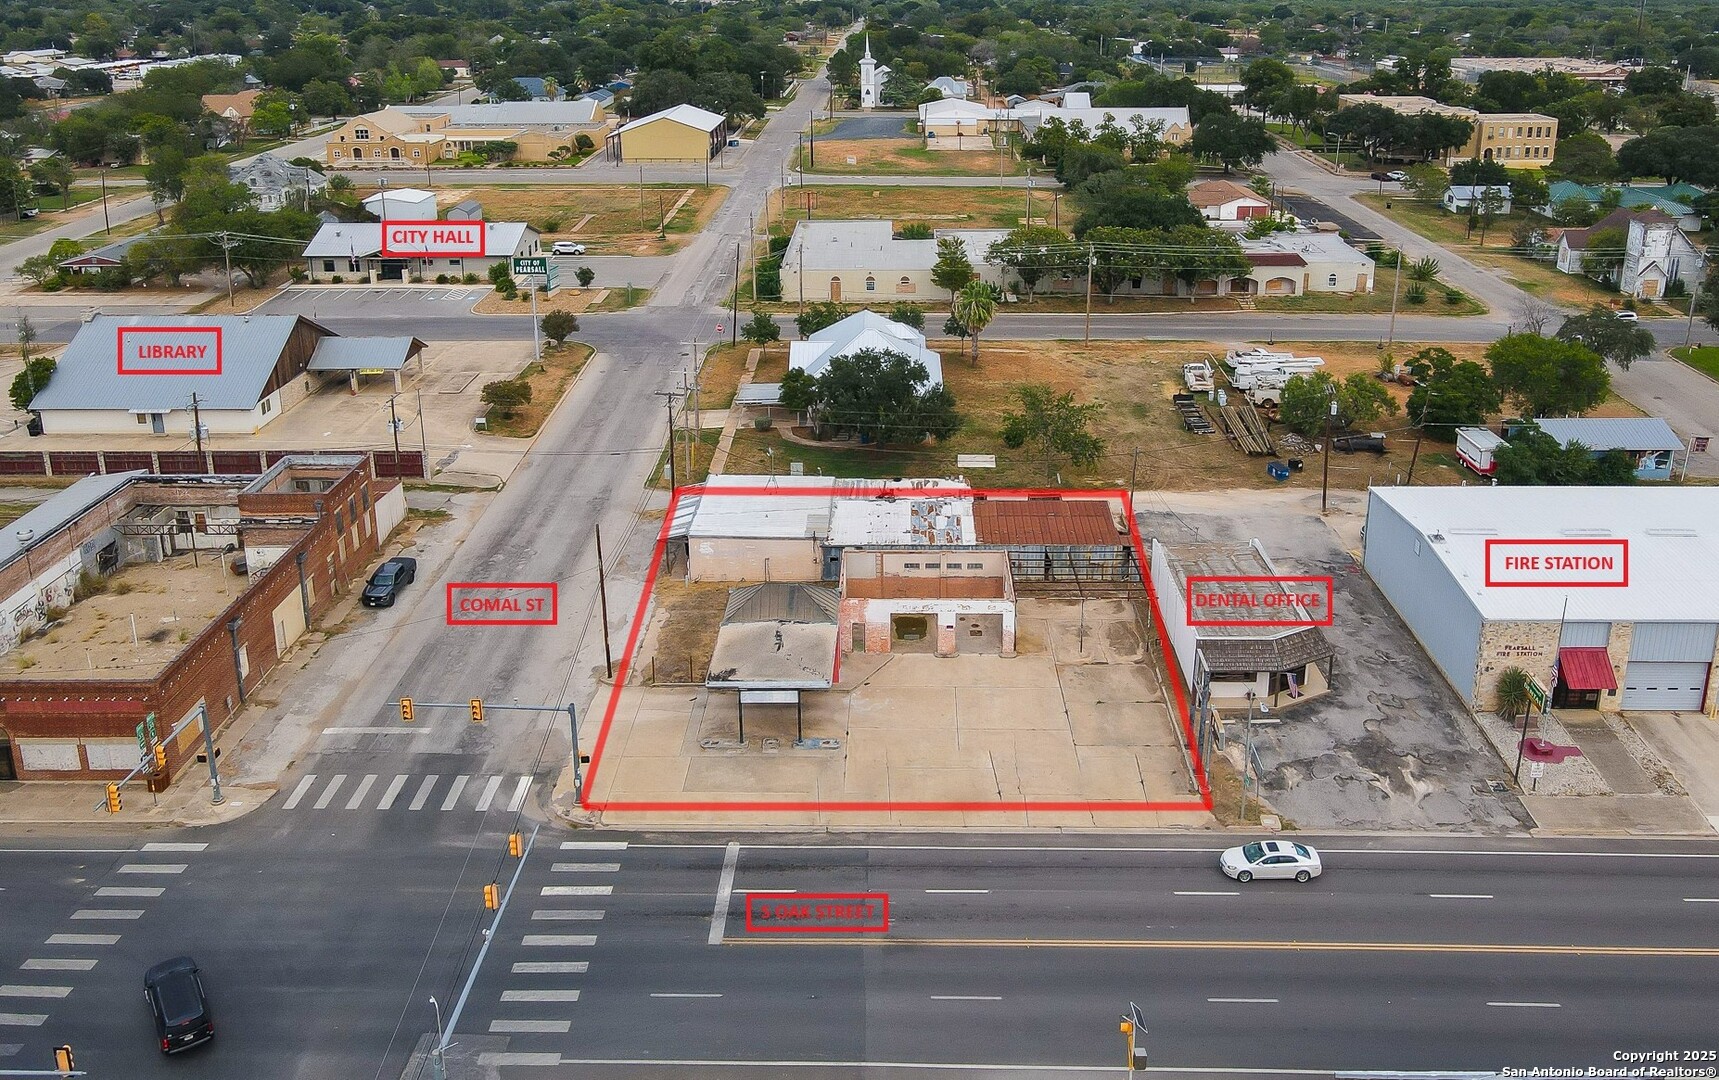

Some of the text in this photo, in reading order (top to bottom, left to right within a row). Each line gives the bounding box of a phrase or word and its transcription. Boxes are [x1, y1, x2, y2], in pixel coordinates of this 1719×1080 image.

[519, 259, 541, 267] CITY OF
[515, 265, 546, 274] PEARSALL
